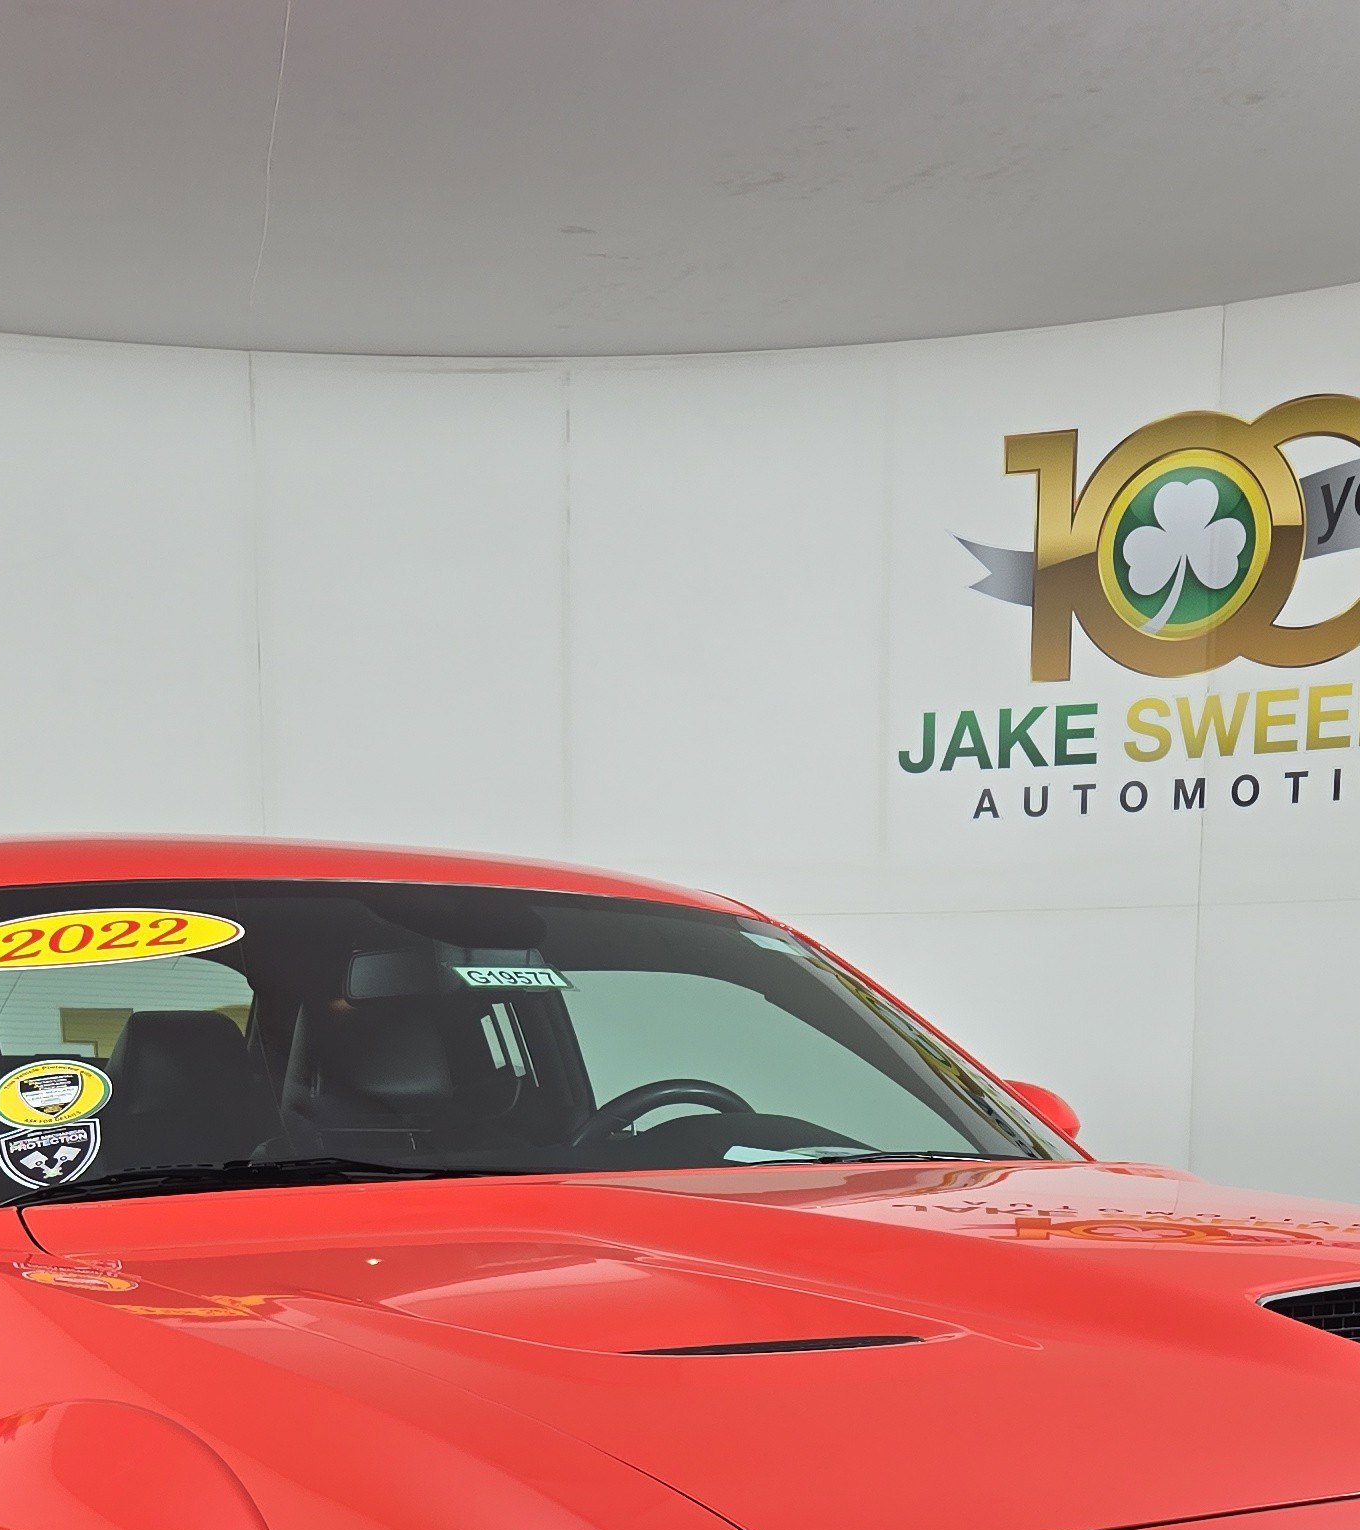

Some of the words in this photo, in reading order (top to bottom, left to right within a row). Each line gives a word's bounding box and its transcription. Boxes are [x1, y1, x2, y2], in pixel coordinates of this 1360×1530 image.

[897, 703, 1098, 774] JAKE
[467, 971, 556, 985] G19577
[9, 1133, 89, 1154] PROTECTION
